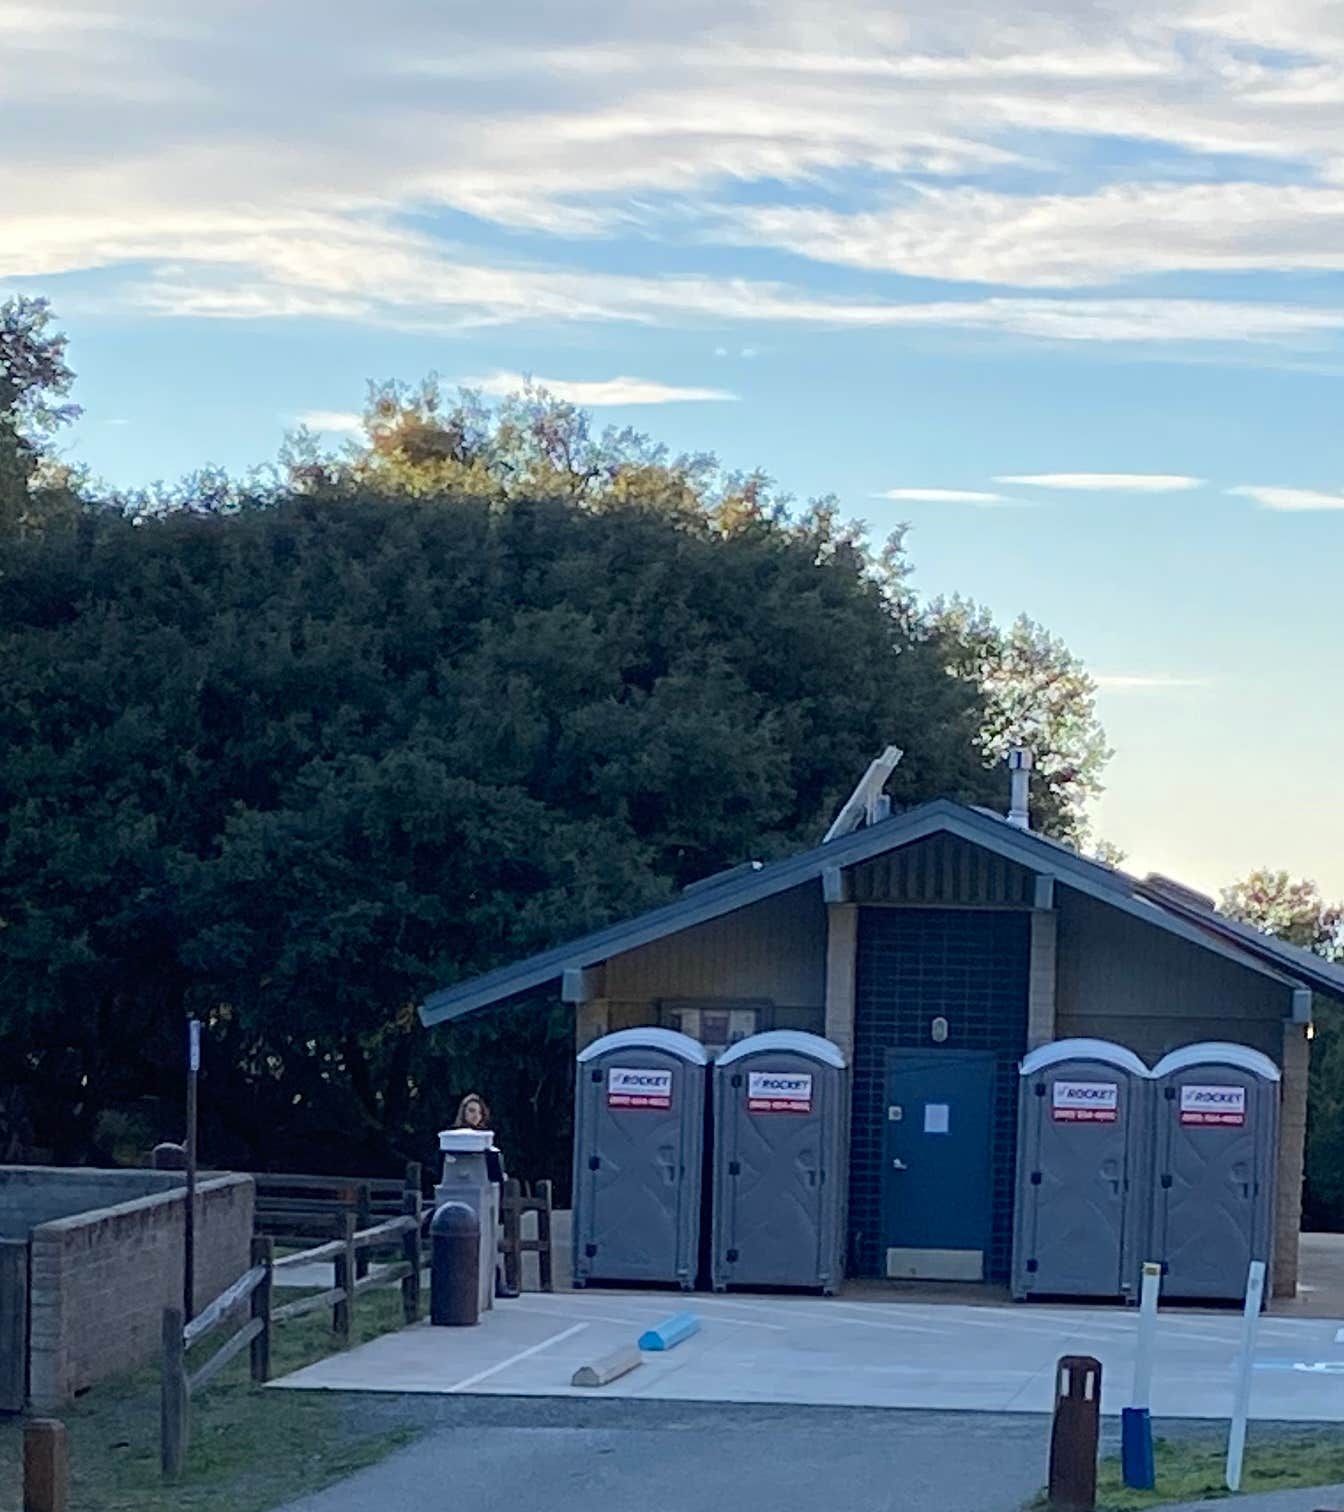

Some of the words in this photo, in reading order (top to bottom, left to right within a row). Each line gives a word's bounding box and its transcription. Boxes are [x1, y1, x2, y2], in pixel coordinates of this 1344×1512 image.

[622, 1075, 668, 1086] ROCKET
[762, 1079, 808, 1089] ROCKET
[1067, 1089, 1114, 1099] ROCKET
[1195, 1092, 1242, 1103] ROCKET
